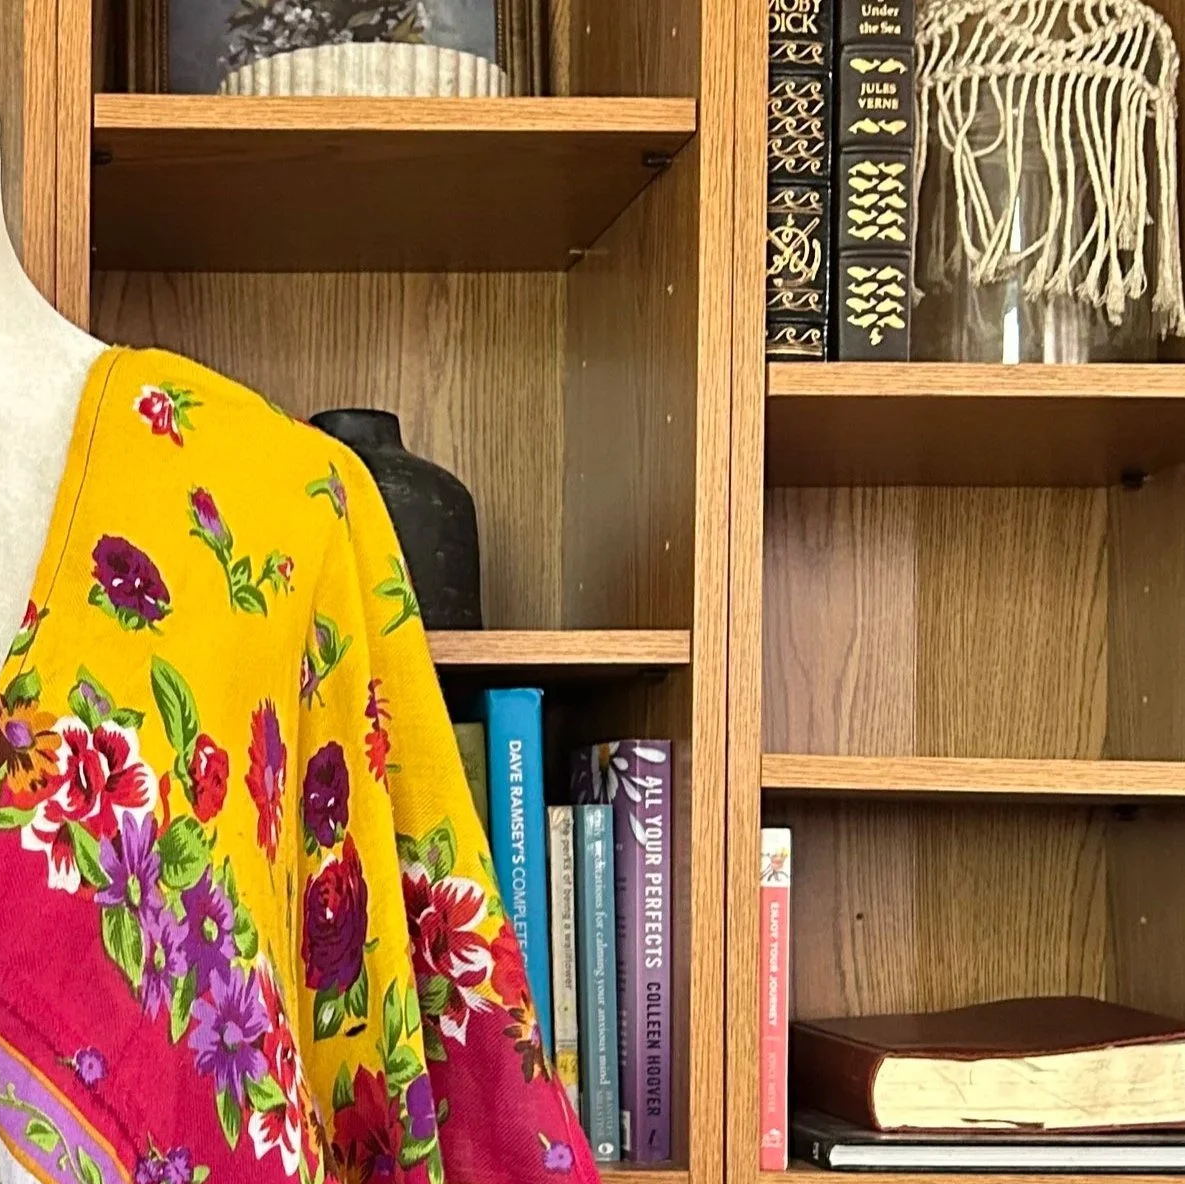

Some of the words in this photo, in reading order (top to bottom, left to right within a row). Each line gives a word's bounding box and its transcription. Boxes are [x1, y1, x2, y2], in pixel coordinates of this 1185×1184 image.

[859, 21, 878, 34] the
[880, 21, 901, 34] Sea
[861, 4, 899, 17] Under
[858, 98, 899, 110] VERNE
[860, 82, 897, 96] JULES
[509, 740, 522, 782] DAVE
[645, 775, 663, 808] ALL
[511, 786, 525, 864] RAMSEY'S
[645, 815, 663, 866] YOUR
[645, 873, 663, 969] PERFECTS
[646, 982, 661, 1050] COLLEEN
[599, 1054, 611, 1085] mind
[646, 1055, 661, 1116] HOOVER
